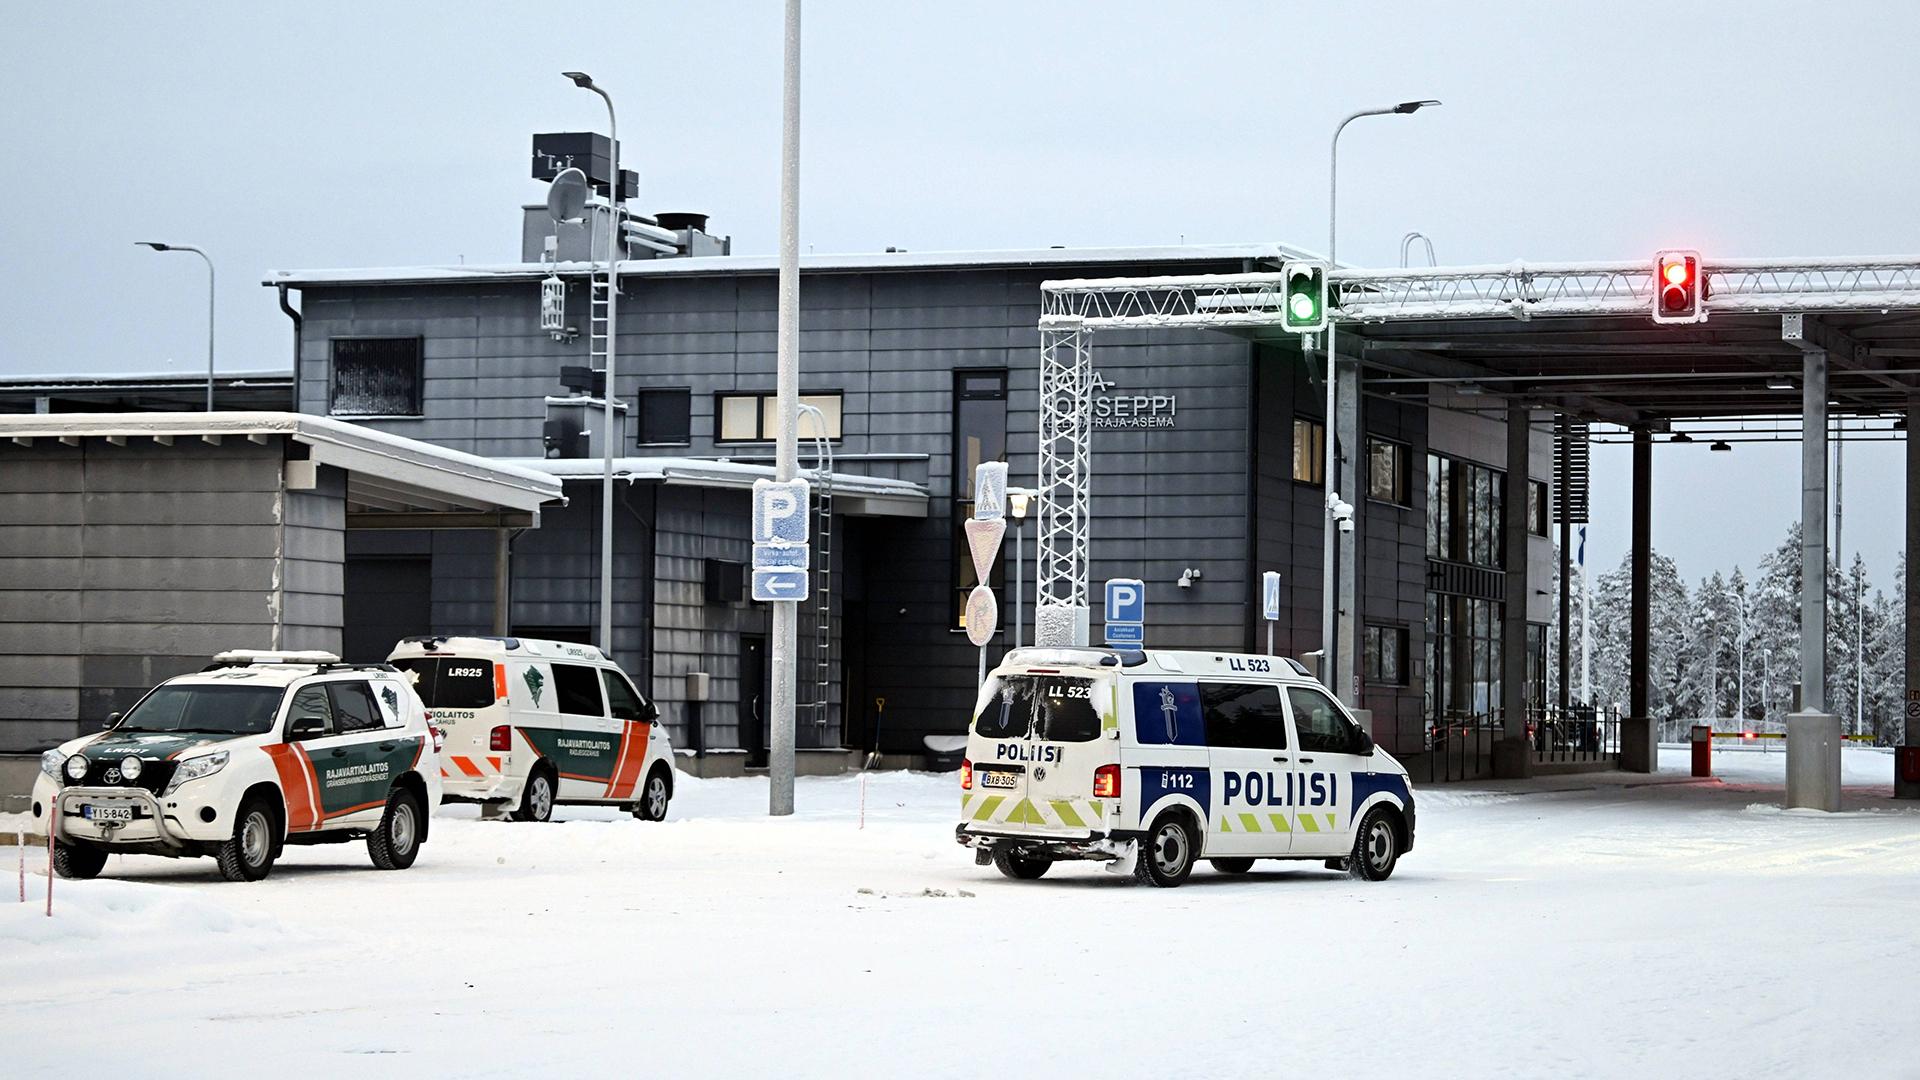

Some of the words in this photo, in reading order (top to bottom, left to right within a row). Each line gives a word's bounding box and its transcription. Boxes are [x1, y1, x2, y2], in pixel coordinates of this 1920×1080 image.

[1095, 417, 1175, 428] RAJA-ASEMA
[764, 490, 797, 538] P
[1112, 586, 1137, 619] P
[1229, 658, 1246, 672] LL
[1248, 659, 1270, 672] 523
[447, 667, 483, 678] LR925
[1048, 685, 1064, 698] LL
[1067, 687, 1092, 699] 523
[557, 738, 611, 750] RAJAVARTIOLAITOS
[997, 743, 1062, 763] POLIISI
[326, 762, 389, 779] RAJAVARTIOLAITOS
[1170, 773, 1194, 788] 112
[1223, 771, 1337, 806] POLIISI
[93, 808, 130, 819] YIS-842
